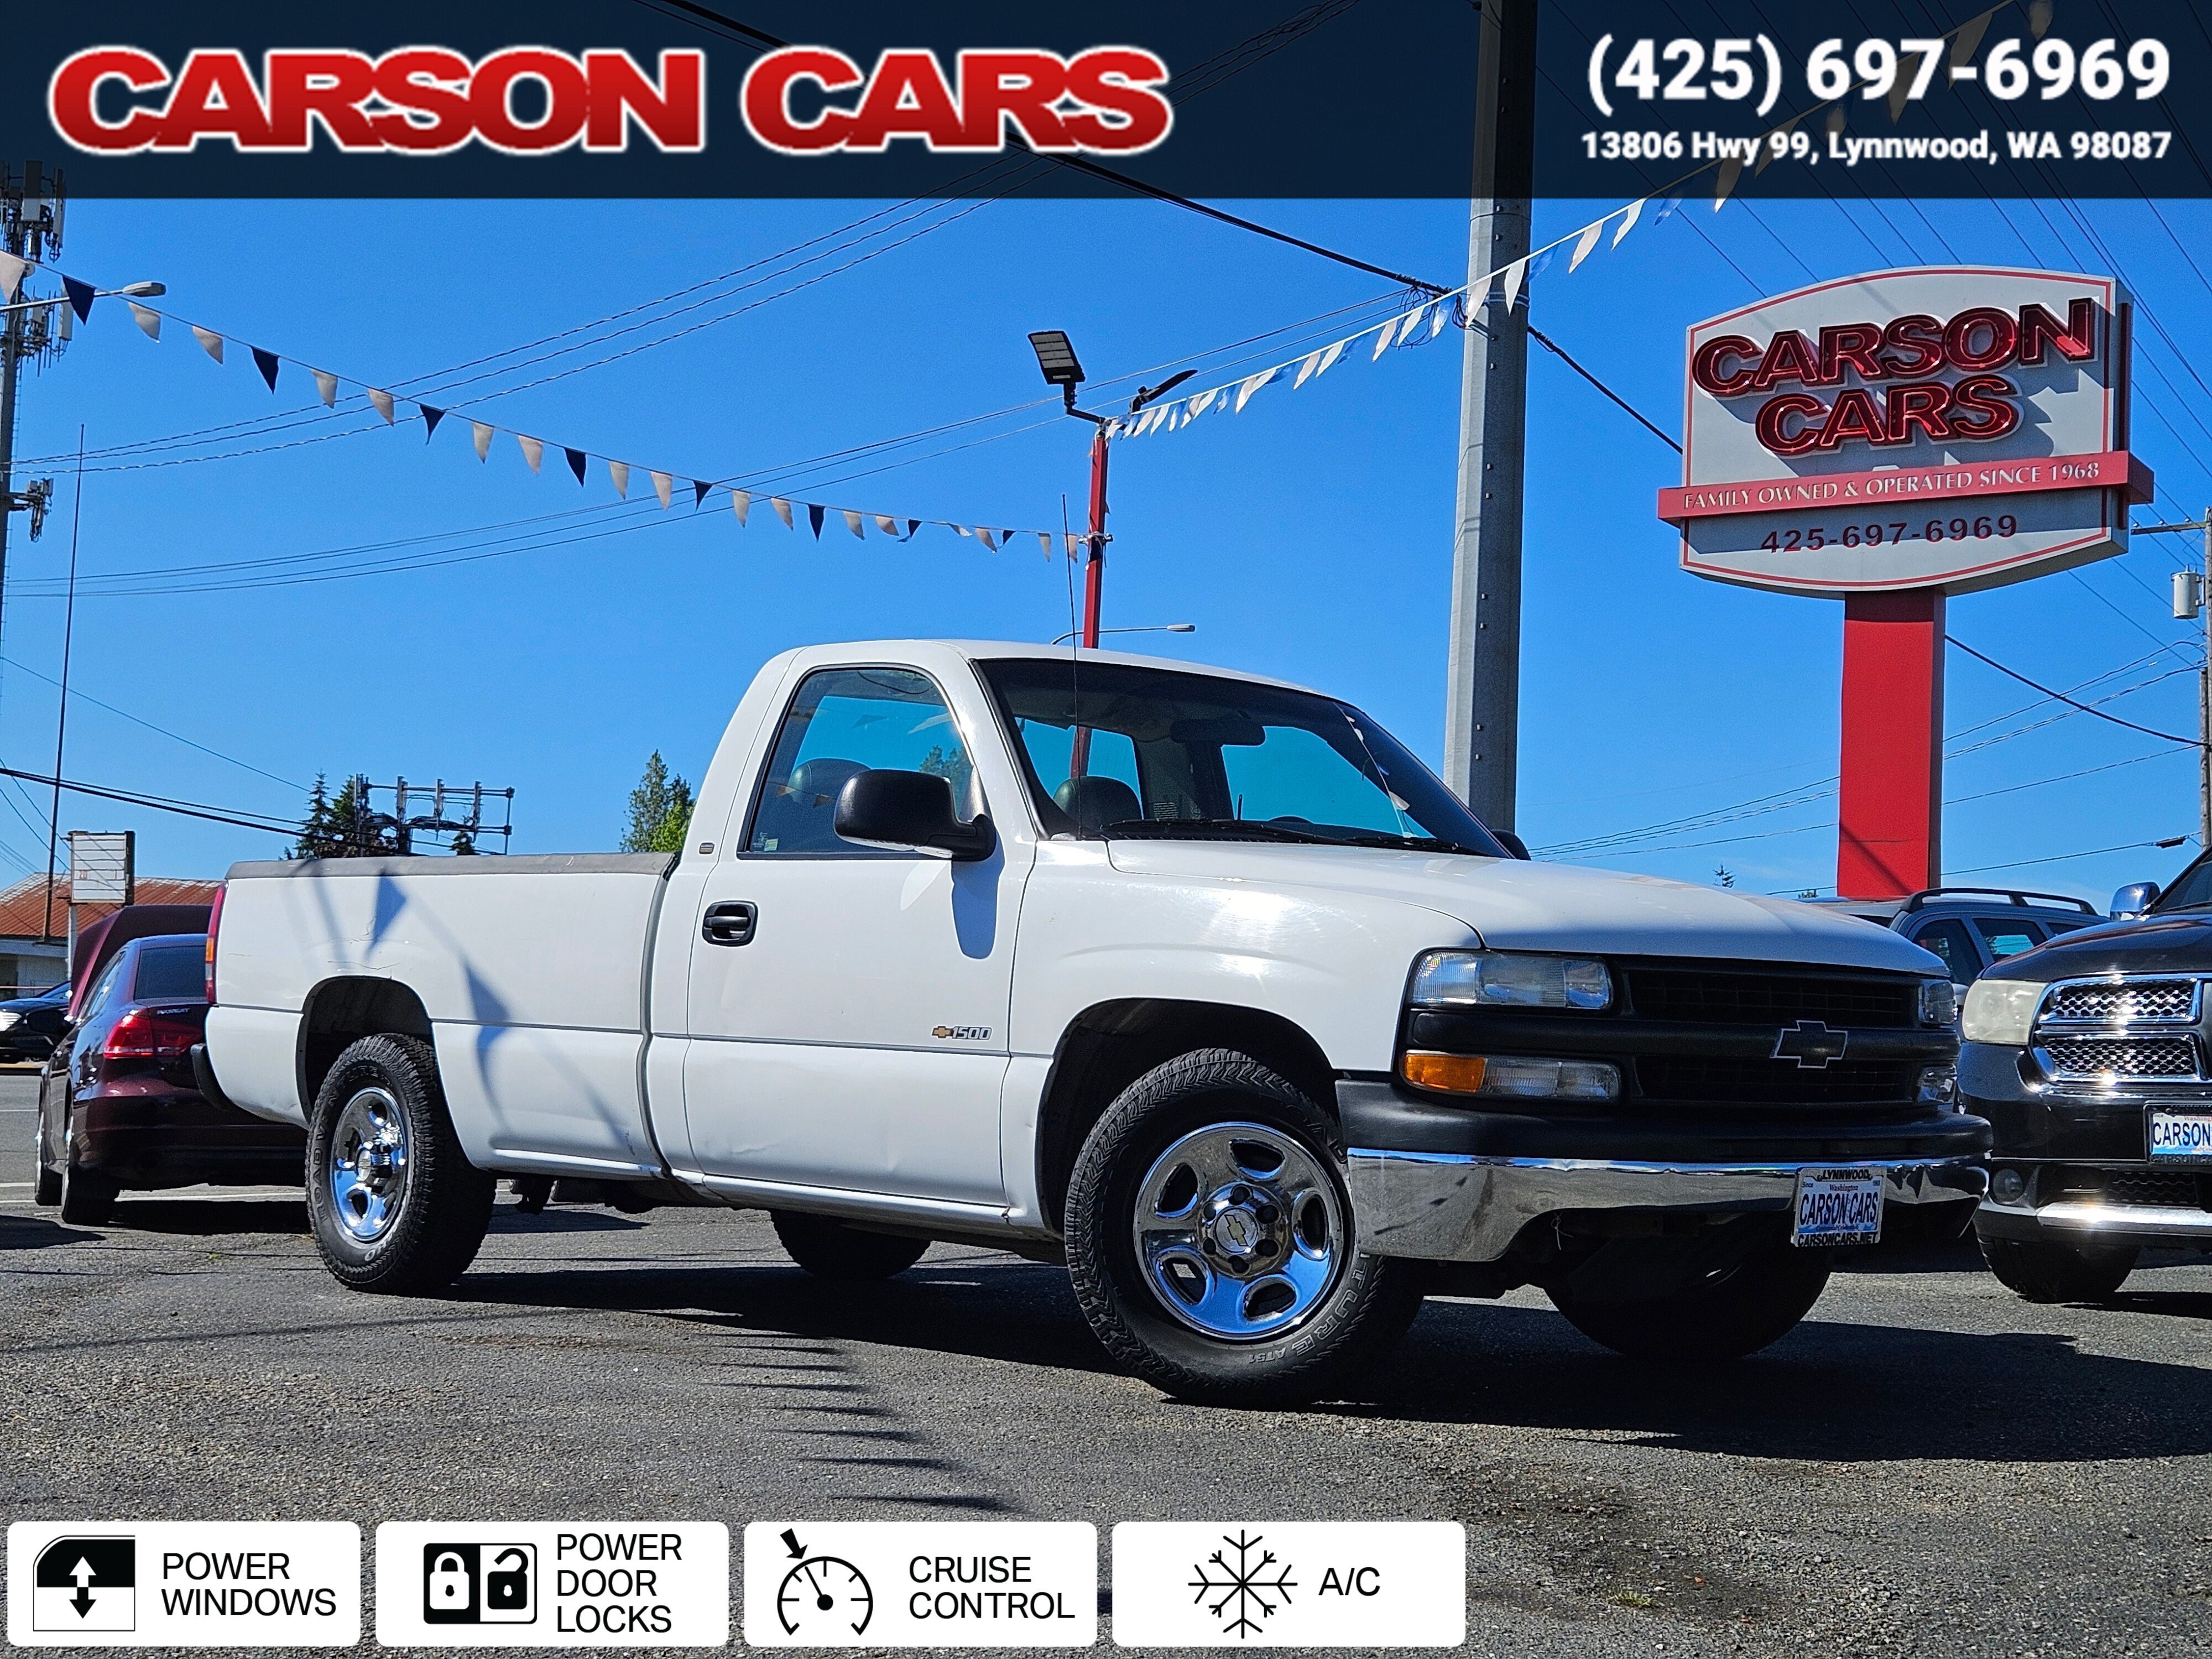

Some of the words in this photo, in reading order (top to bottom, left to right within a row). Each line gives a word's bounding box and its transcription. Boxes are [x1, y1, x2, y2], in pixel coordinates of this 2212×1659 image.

[1692, 297, 2096, 395] CARSON
[1755, 377, 2020, 455] CARS
[1684, 489, 1752, 509] FAMILY
[1758, 483, 1838, 503] OWNED
[1844, 481, 1859, 497] &
[1865, 471, 1973, 494] OPERATED
[1980, 466, 2041, 487] SINCE
[2048, 462, 2100, 481] 1968
[1761, 514, 2017, 554] 425-697-6969
[952, 1027, 992, 1040] 1500
[2153, 1122, 2211, 1146] CARSON
[1799, 1193, 1849, 1225] CARSON
[1849, 1192, 1879, 1224] CARS
